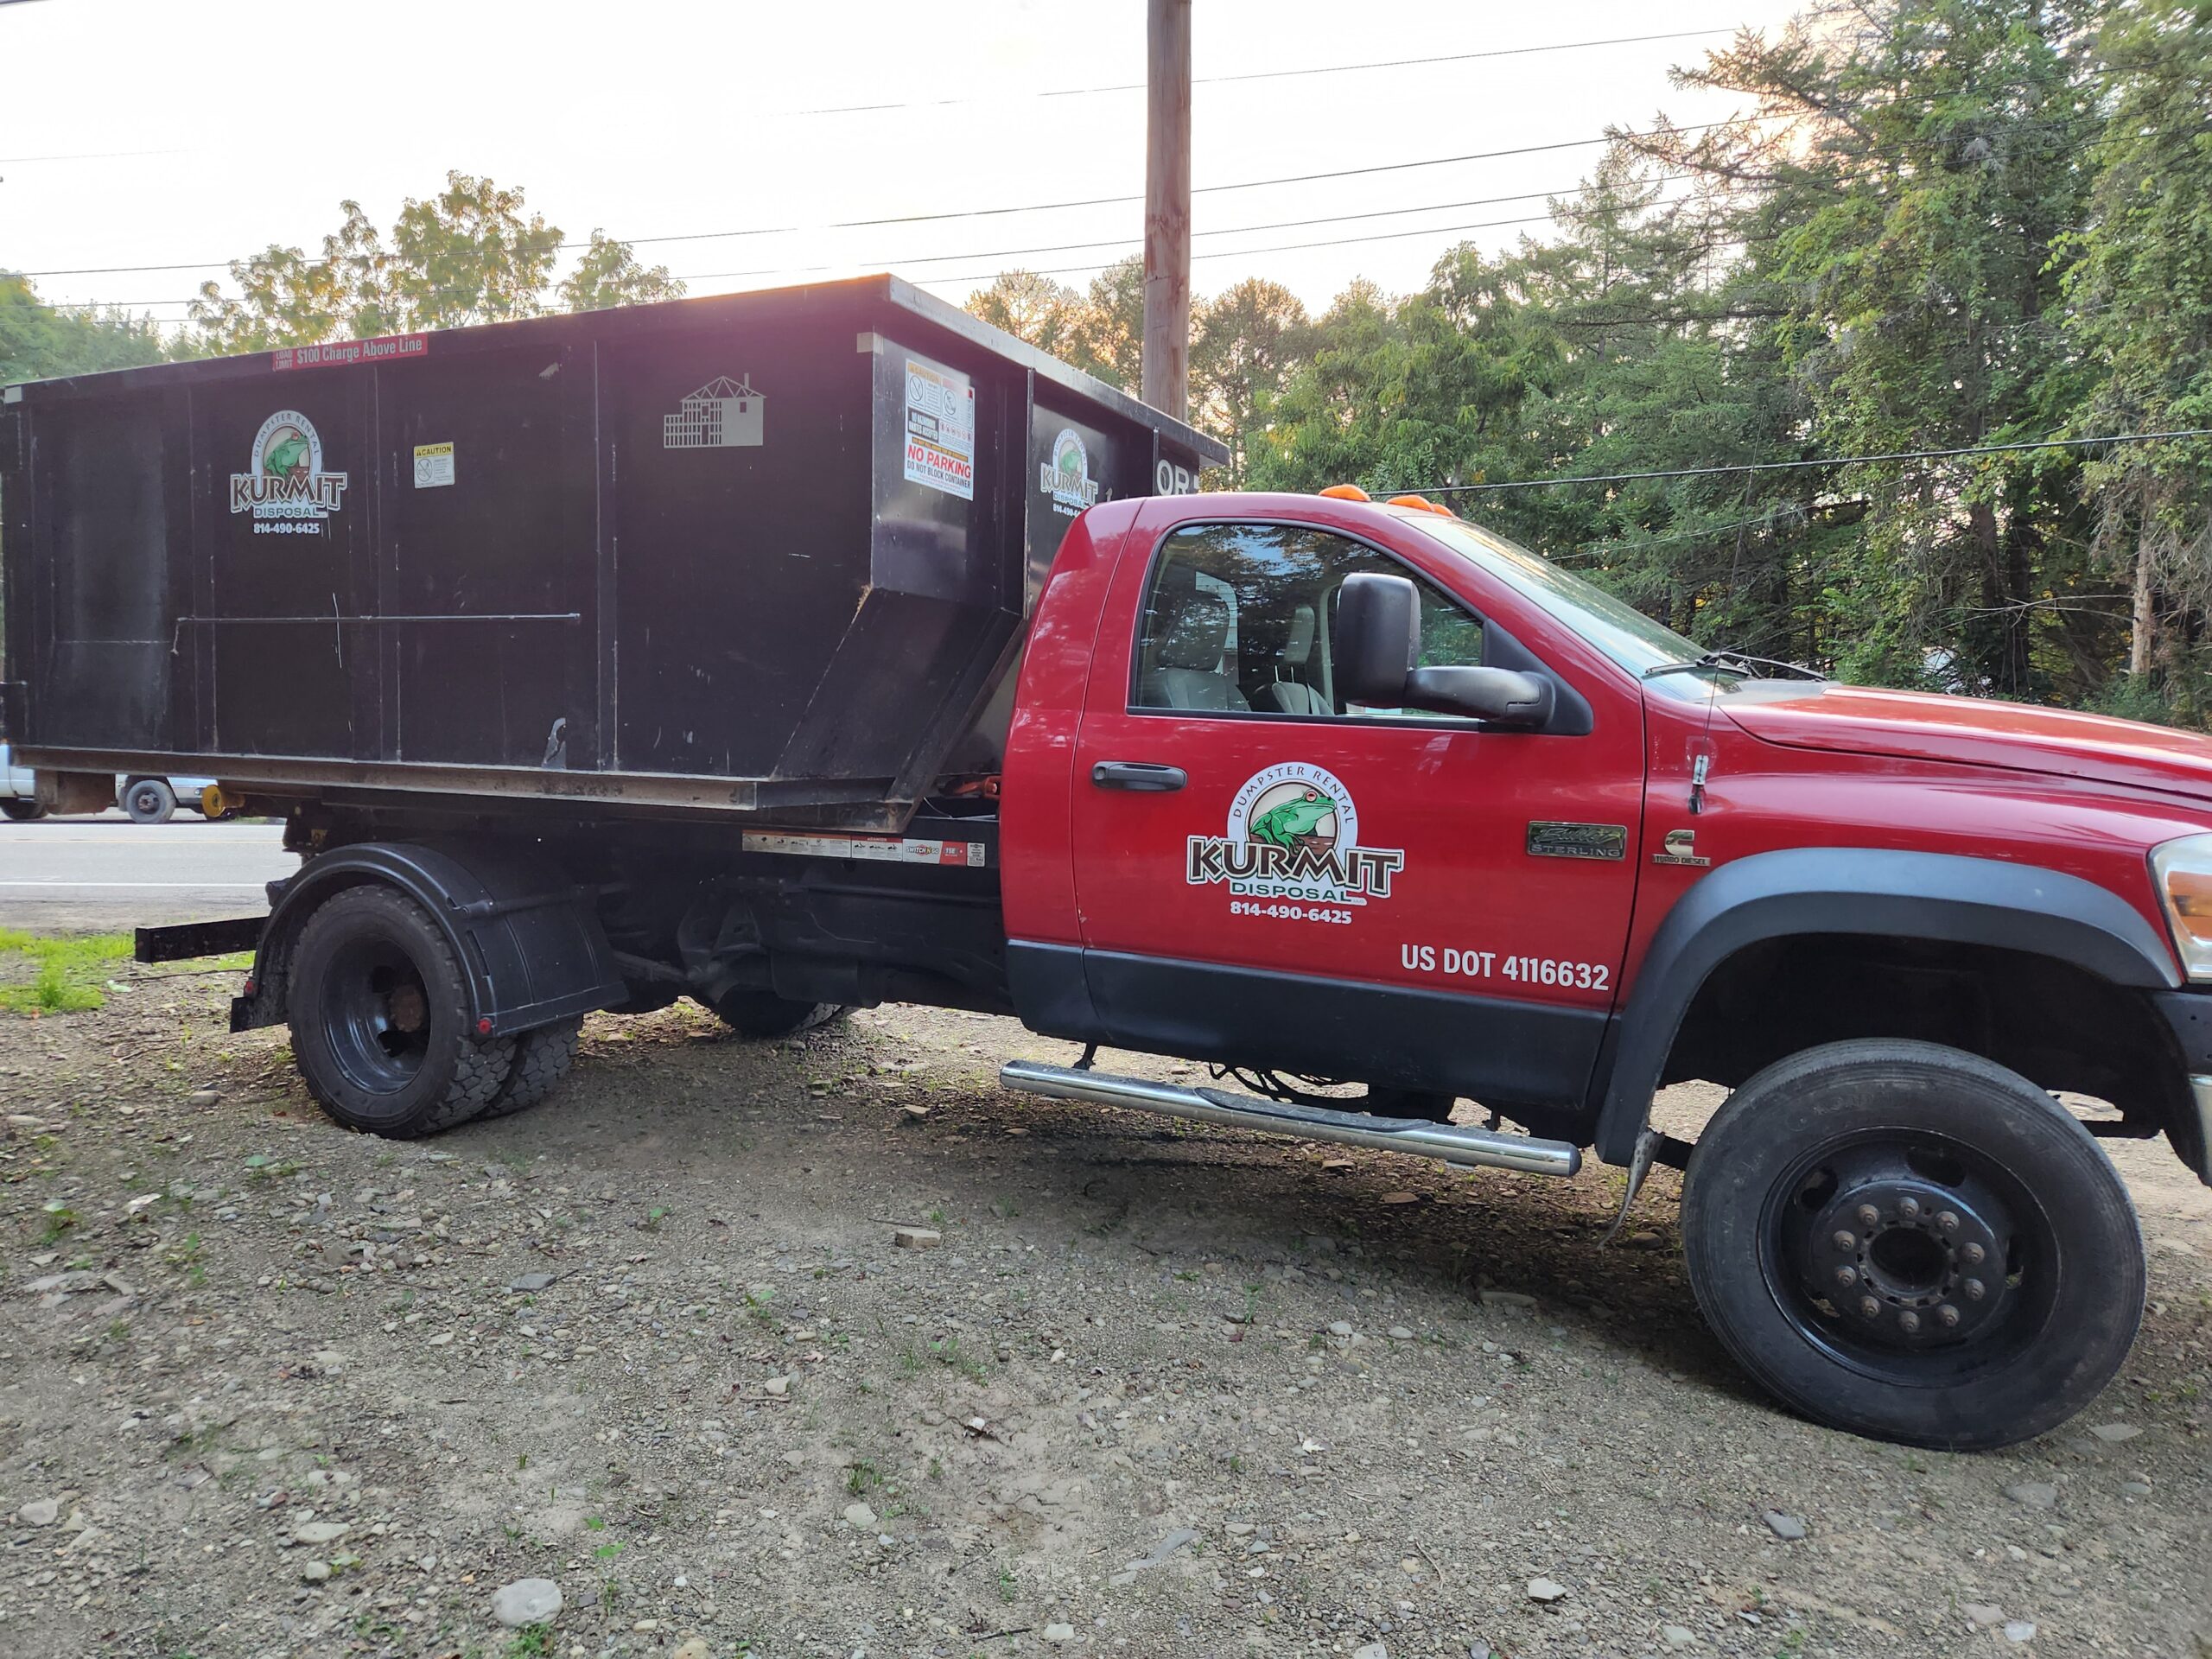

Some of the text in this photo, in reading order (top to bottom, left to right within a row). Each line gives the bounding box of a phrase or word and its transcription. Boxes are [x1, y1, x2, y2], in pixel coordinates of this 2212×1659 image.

[276, 349, 293, 359] LOAD
[297, 338, 423, 365] $100 Charge Above Line
[276, 359, 293, 370] LIMIT
[254, 413, 320, 457] DUMPSTER RENTAL
[422, 446, 452, 456] CAUTION
[907, 444, 925, 462] NO
[926, 451, 971, 479] PARKING
[907, 460, 915, 470] DO
[916, 463, 927, 474] NOT
[927, 467, 944, 480] BLOCK
[944, 473, 971, 490] CONTAINER
[1040, 462, 1098, 505] KURMIT
[231, 474, 346, 512] KURMIT
[1054, 493, 1086, 508] DISPOSAL
[255, 507, 320, 517] DISPOSAL
[1053, 503, 1080, 518] 814-490-6
[253, 523, 321, 534] 814-490-6425
[1233, 766, 1355, 824] DUMPSTER RENTAL
[1531, 844, 1621, 857] STERLING
[1656, 855, 1707, 865] TURBO DIESEL
[1189, 838, 1402, 895] KURMIT
[1231, 882, 1352, 902] DISPOSAL
[1230, 901, 1352, 925] 814-490-6425
[1402, 944, 1610, 991] US DOT 4116632
